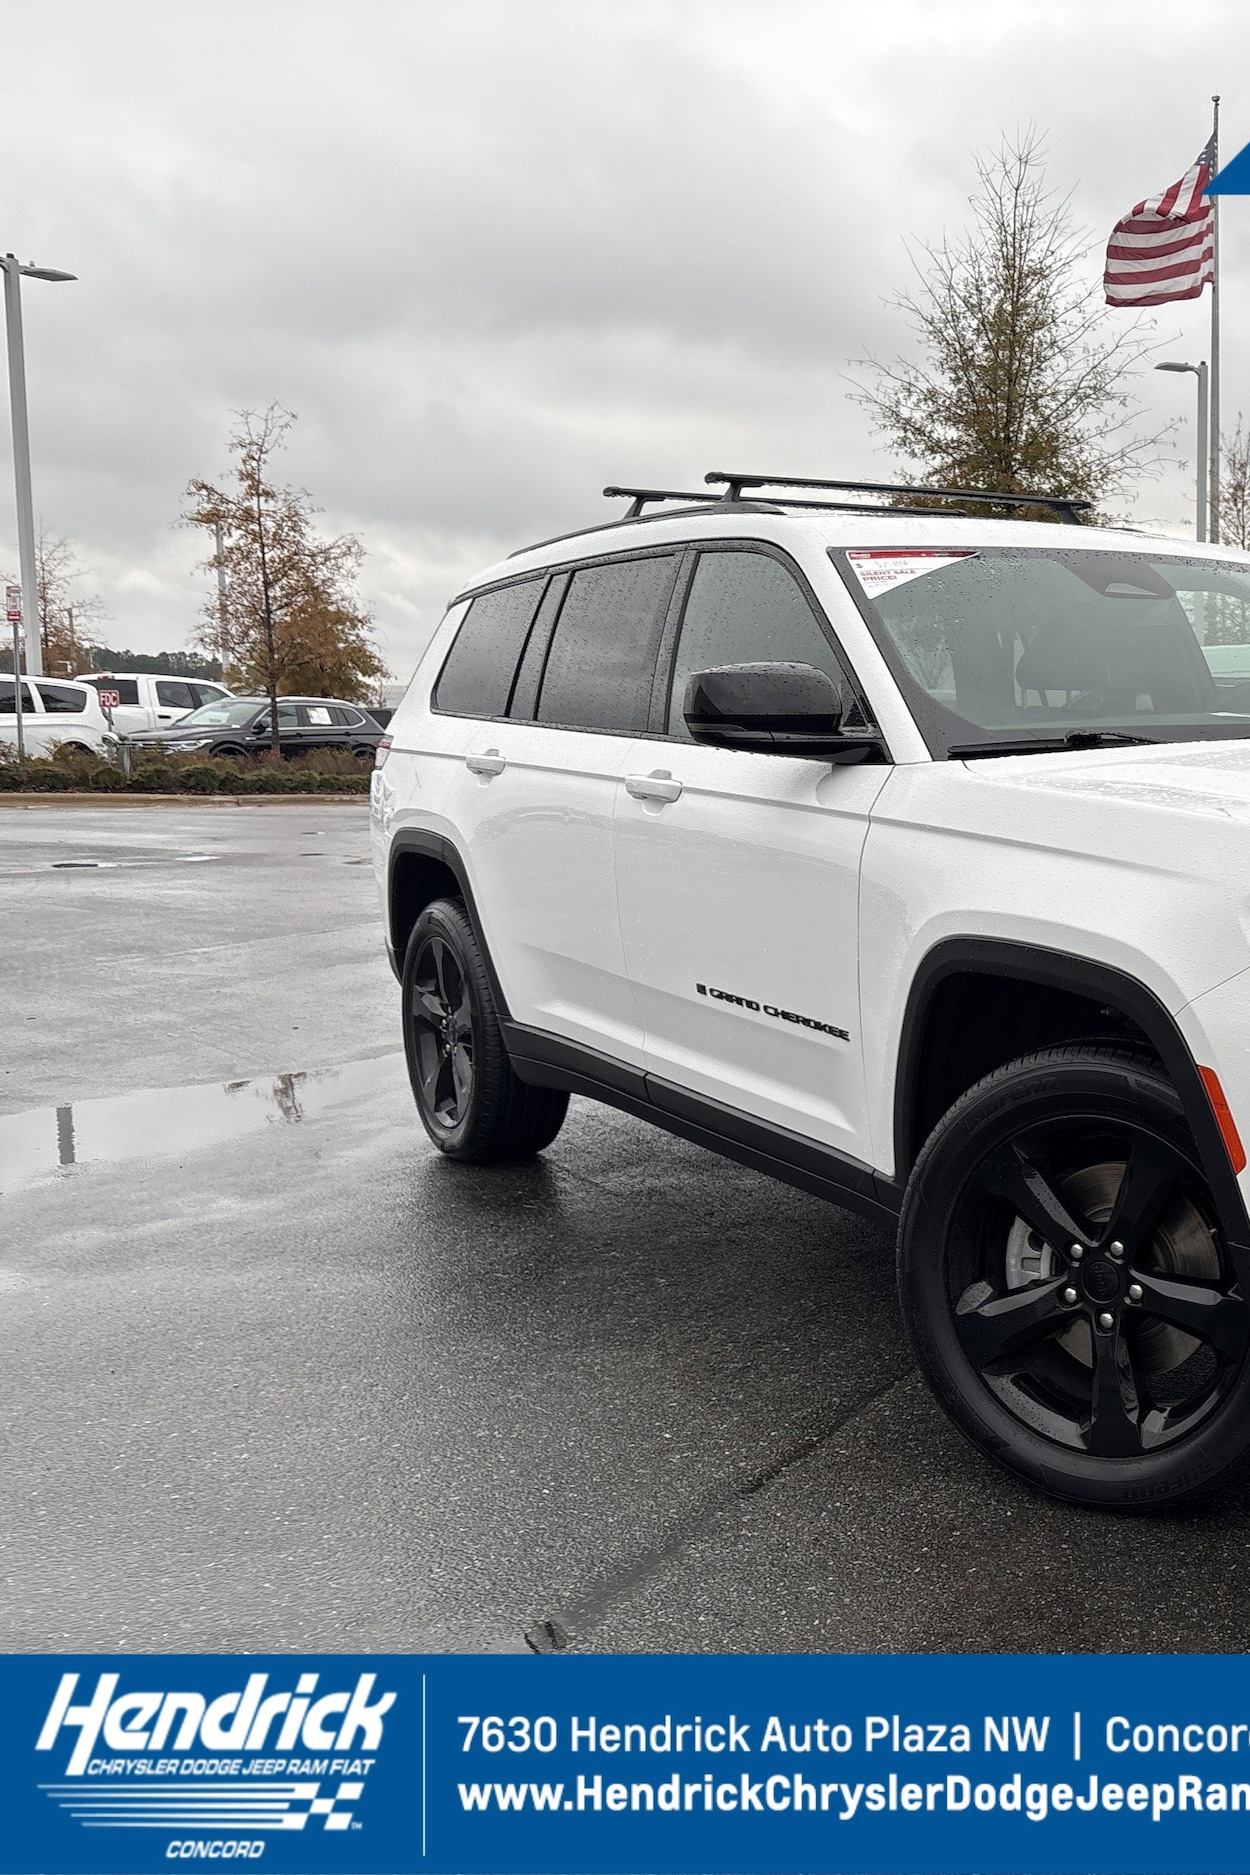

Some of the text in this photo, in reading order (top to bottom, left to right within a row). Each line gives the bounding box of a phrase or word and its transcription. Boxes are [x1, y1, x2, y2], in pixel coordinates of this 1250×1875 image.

[100, 692, 118, 706] FDC
[709, 988, 850, 1042] GRAND CHEROKEE
